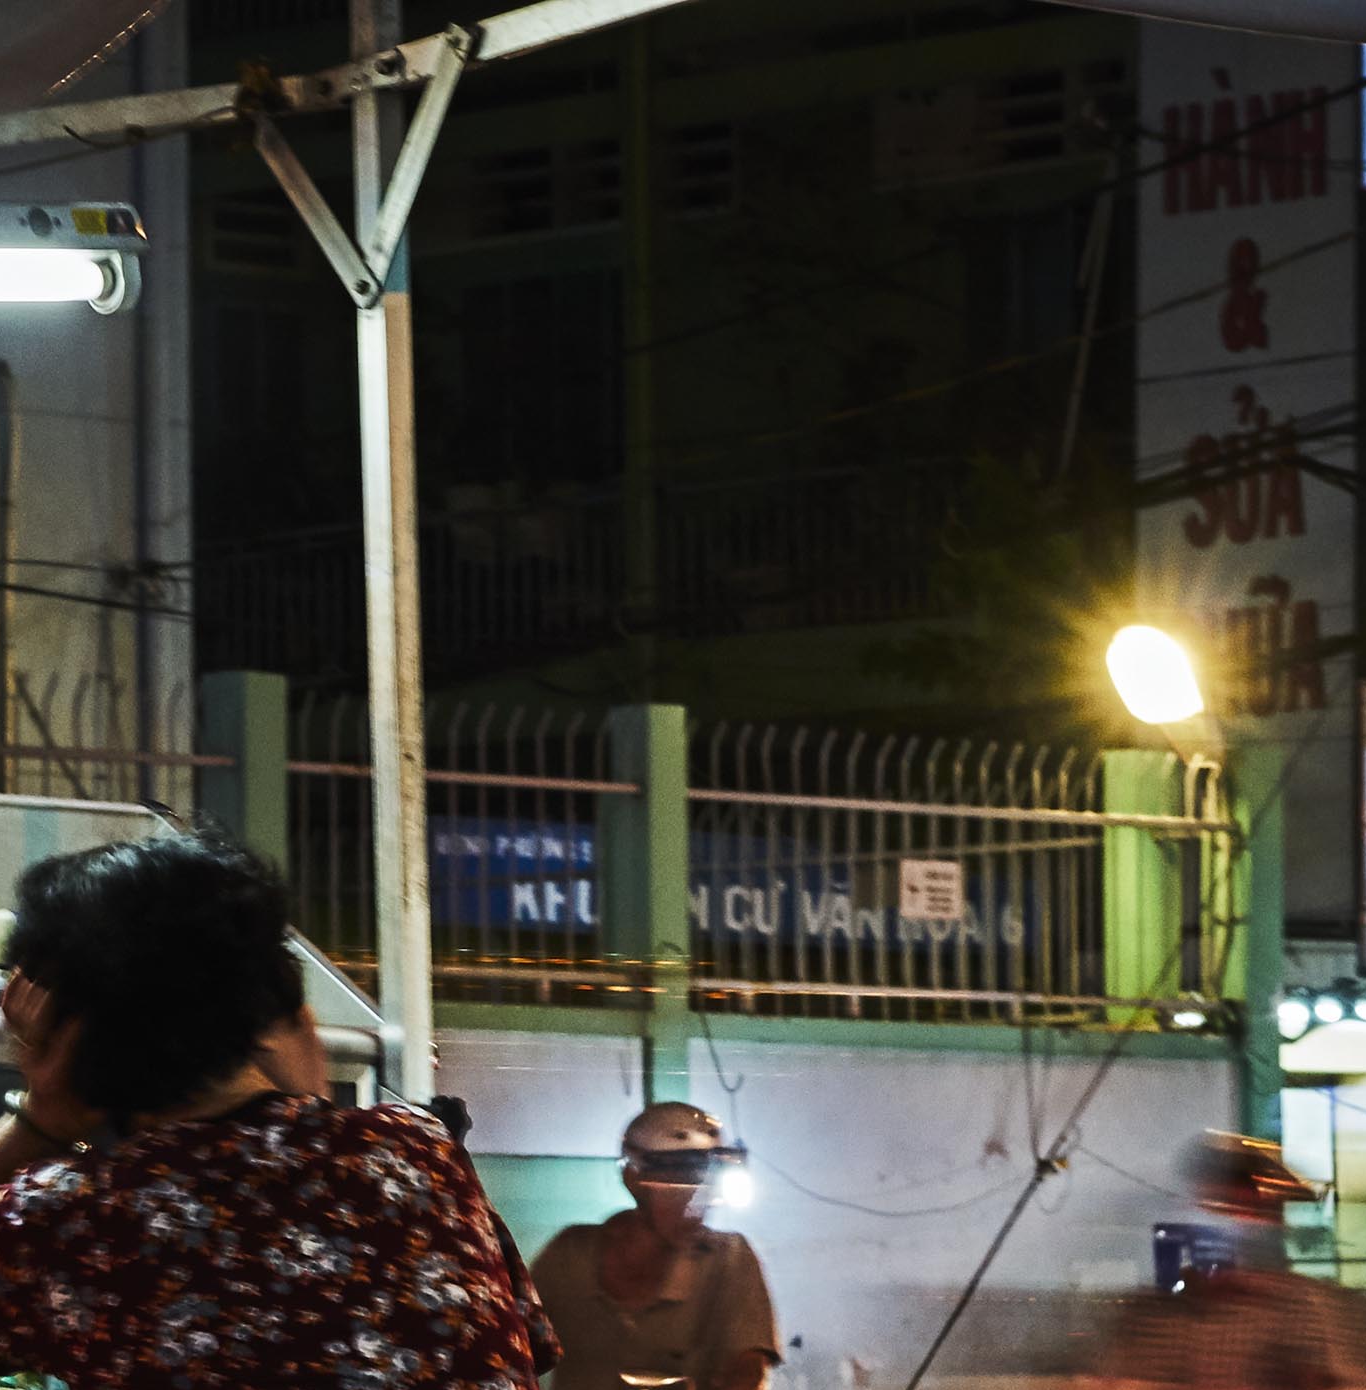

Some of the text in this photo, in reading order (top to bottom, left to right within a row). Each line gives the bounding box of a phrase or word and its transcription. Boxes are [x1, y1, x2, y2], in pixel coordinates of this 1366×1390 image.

[1162, 67, 1328, 216] HÀNH
[1218, 238, 1268, 353] &
[1184, 384, 1307, 549] SỬA
